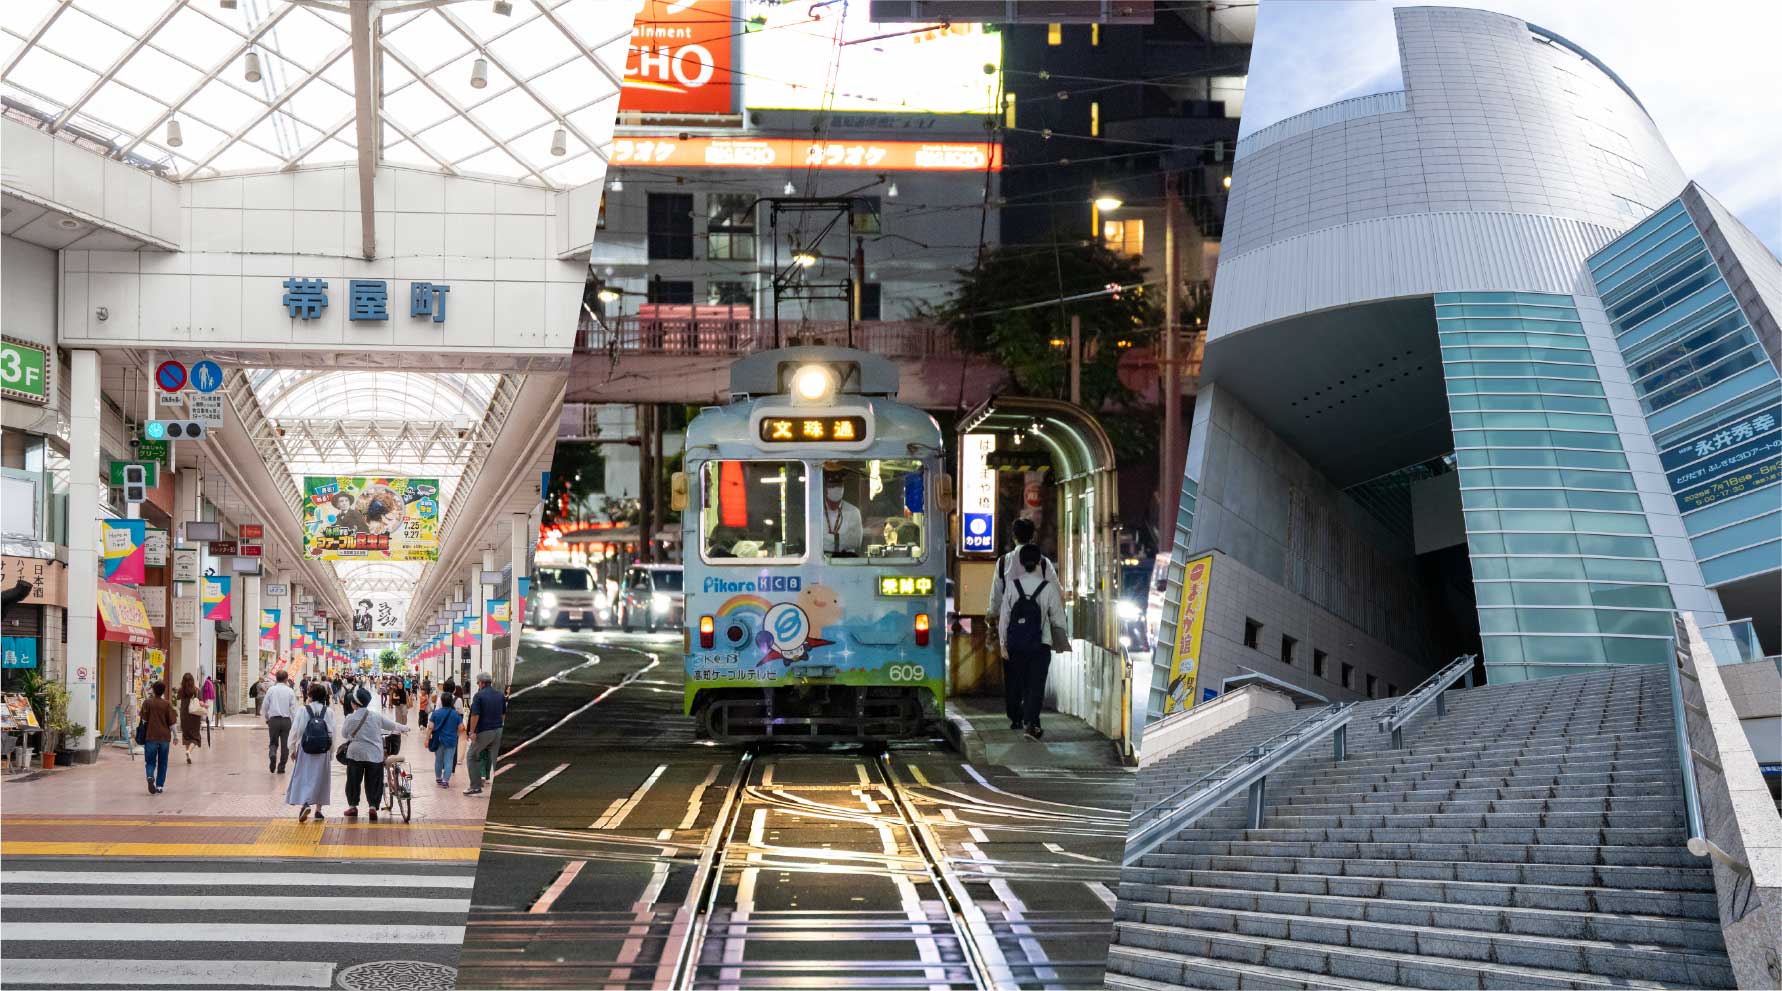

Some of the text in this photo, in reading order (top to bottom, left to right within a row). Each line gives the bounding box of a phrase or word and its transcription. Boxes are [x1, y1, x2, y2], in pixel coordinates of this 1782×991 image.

[283, 277, 450, 323] 帯屋町
[1, 349, 40, 386] 3F
[773, 420, 855, 439] 文珠通
[1695, 414, 1775, 457] 永井秀幸
[403, 521, 420, 530] 7.25
[403, 531, 420, 539] 9.27
[33, 564, 44, 598] 日本酒
[703, 576, 757, 593] Pikara
[694, 669, 777, 681] 高知ケーブルテレビ
[889, 665, 924, 681] 609
